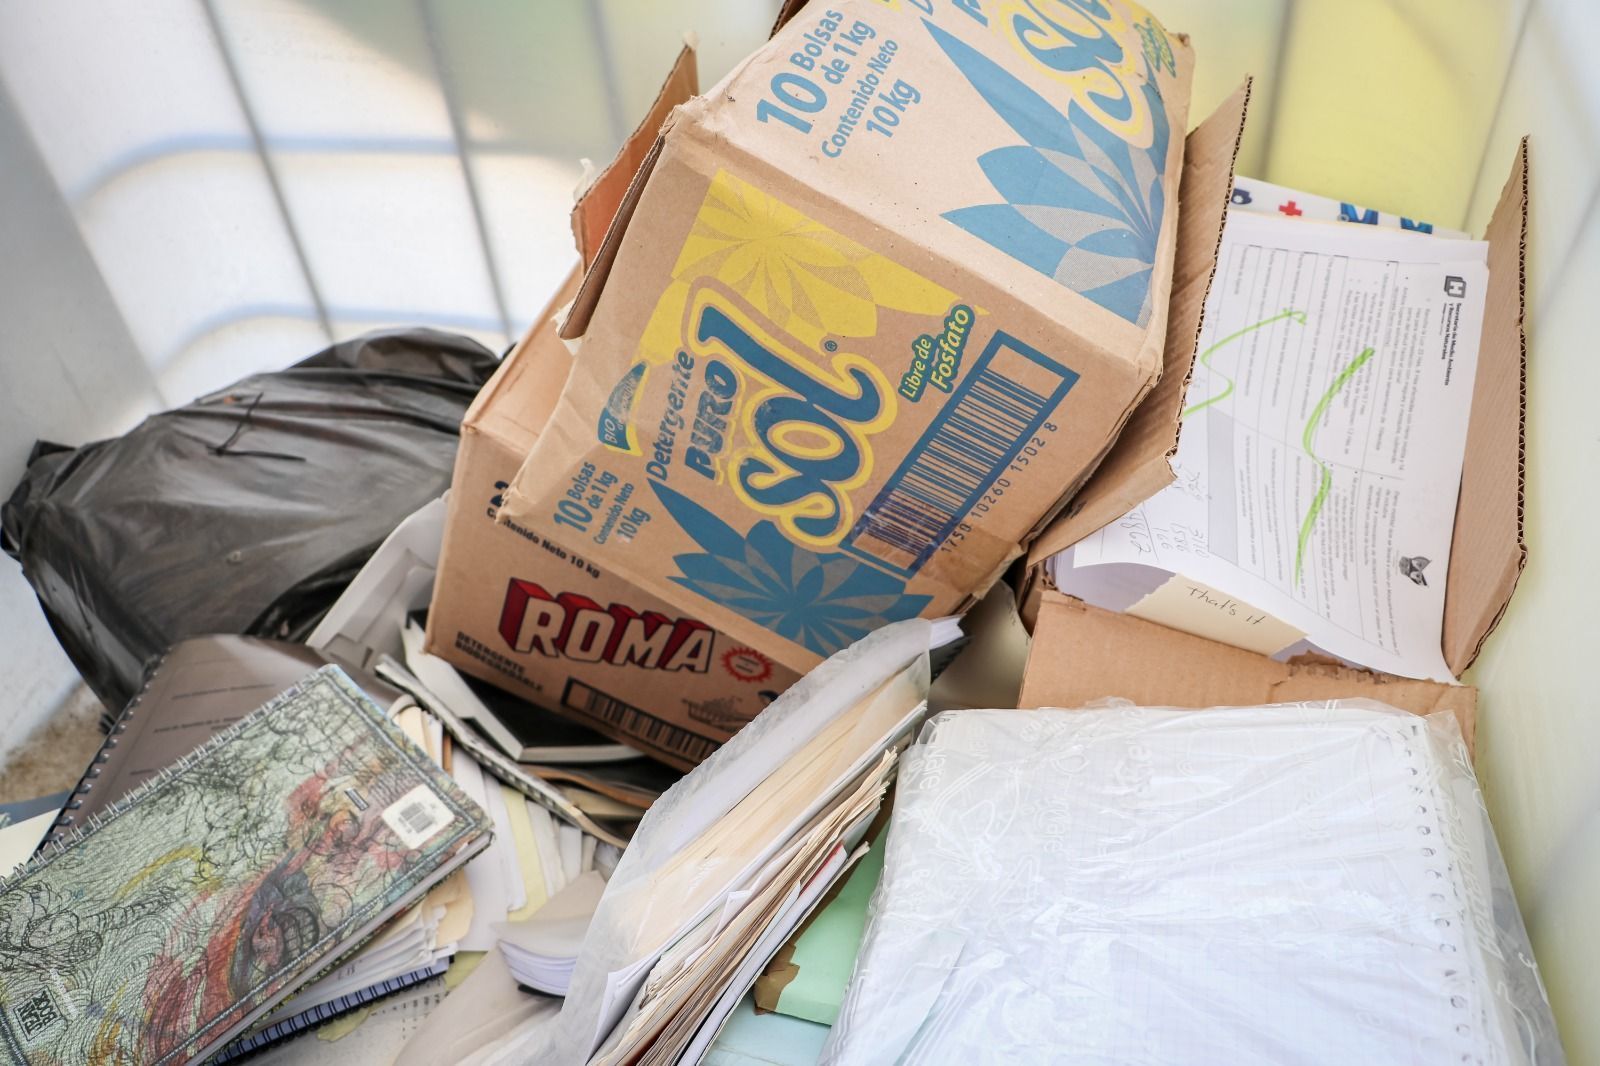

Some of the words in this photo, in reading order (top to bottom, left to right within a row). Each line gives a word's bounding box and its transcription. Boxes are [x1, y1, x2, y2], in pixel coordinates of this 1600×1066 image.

[789, 10, 843, 71] Bolsas
[833, 43, 857, 56] 1
[840, 20, 876, 46] kg
[821, 58, 850, 84] de
[757, 73, 827, 134] 10
[822, 73, 879, 157] Contenido
[867, 40, 898, 74] Neto
[878, 78, 921, 112] kg
[867, 106, 900, 137] 10
[1445, 307, 1453, 332] Recursos
[931, 309, 969, 389] Fosfato
[1441, 333, 1449, 360] Naturales
[902, 359, 925, 398] Libre
[919, 338, 931, 354] de
[1444, 358, 1452, 385] Ambiente
[604, 417, 617, 443] BIO
[646, 351, 694, 481] Detergente
[685, 360, 737, 480] PURO
[567, 462, 596, 500] Bolsas
[592, 483, 607, 495] 1
[598, 471, 618, 488] kg
[941, 524, 972, 554] 1750
[971, 478, 1011, 518] 10260
[1010, 437, 1046, 473] 1502
[1044, 422, 1058, 432] 8
[553, 500, 592, 532] 10
[586, 493, 600, 509] de
[594, 504, 622, 544] Contenido
[614, 483, 634, 509] Neto
[625, 508, 651, 526] kg
[617, 519, 637, 540] 10
[541, 539, 569, 559] Neto
[569, 553, 585, 568] 10
[585, 560, 600, 579] kg
[500, 578, 715, 675] ROMA
[457, 632, 525, 674] DETERGENTE
[17, 1000, 41, 1035] JEAN
[31, 991, 58, 1025] BOOK
